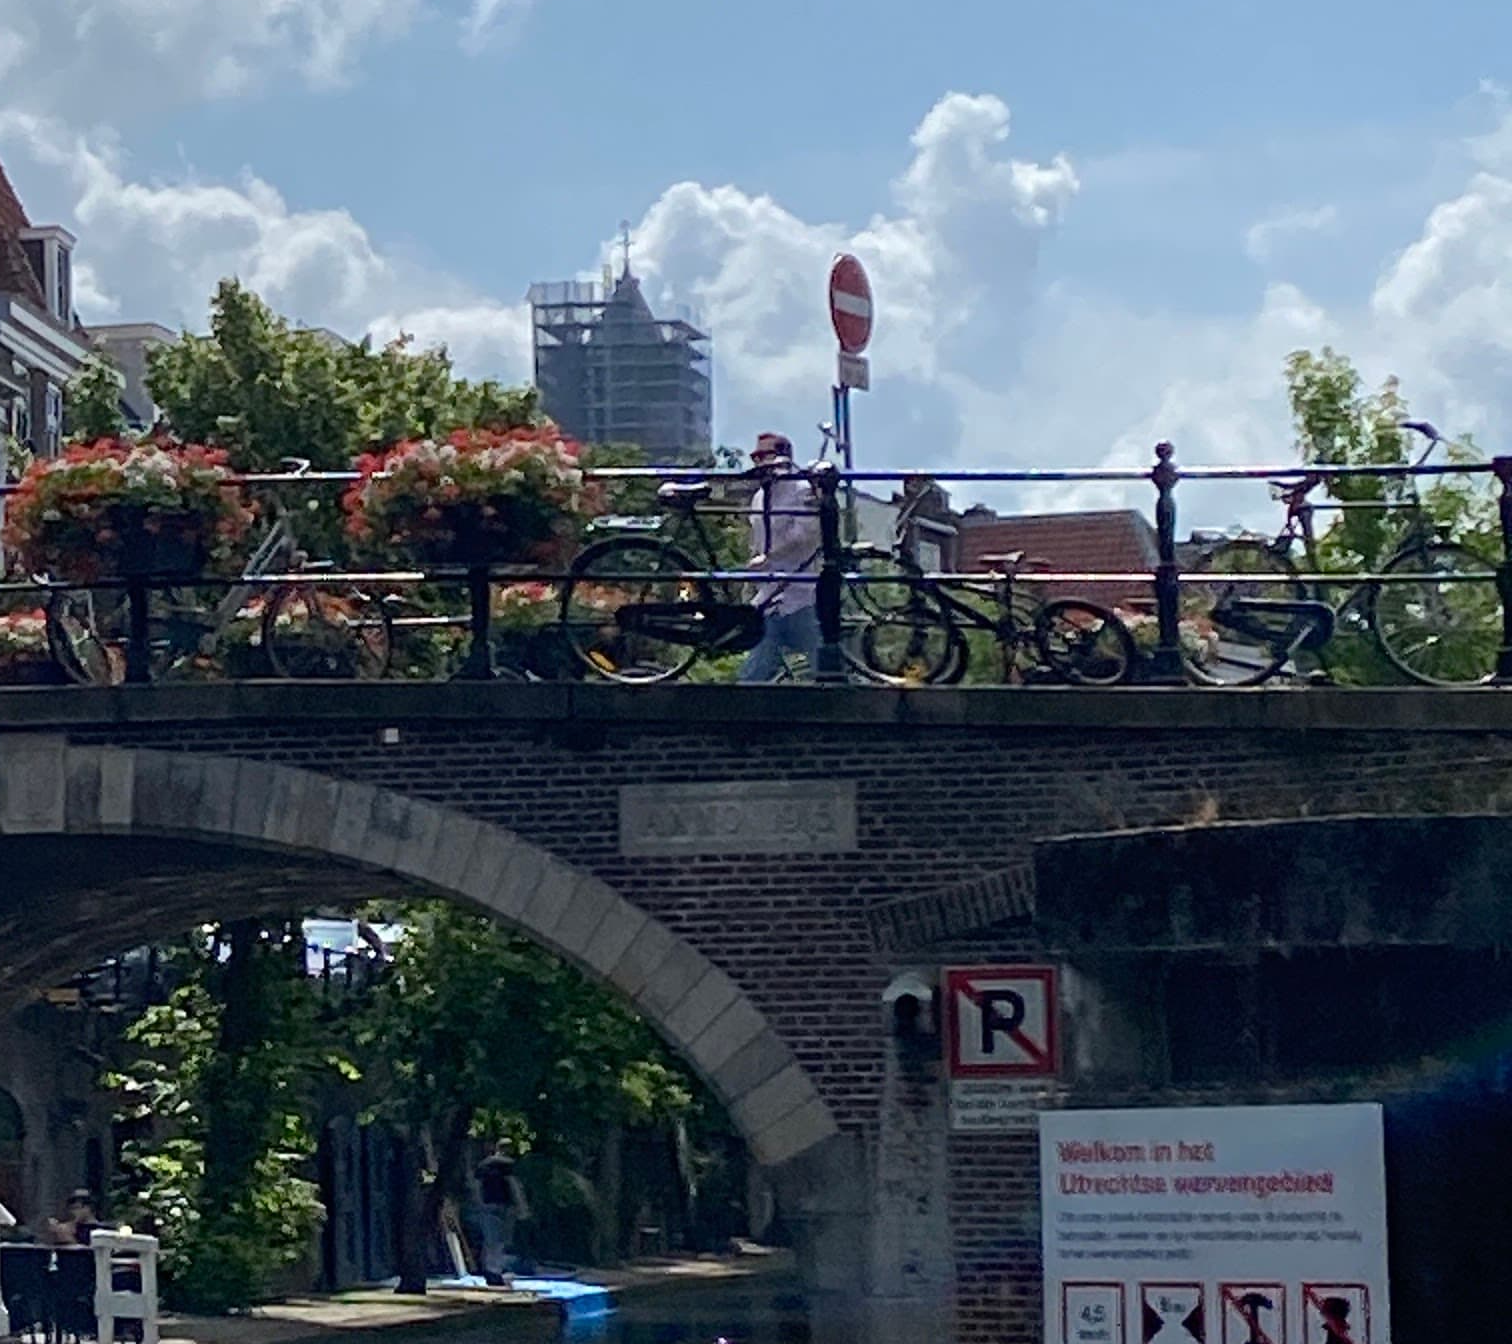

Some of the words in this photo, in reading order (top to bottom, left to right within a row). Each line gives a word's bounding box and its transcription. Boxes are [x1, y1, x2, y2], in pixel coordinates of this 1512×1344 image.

[982, 990, 1025, 1054] P
[1058, 1140, 1145, 1162] Welkom
[1150, 1142, 1172, 1161] in
[1177, 1140, 1215, 1162] het
[1059, 1172, 1167, 1194] Utrechtse
[1174, 1169, 1334, 1198] wervengebied
